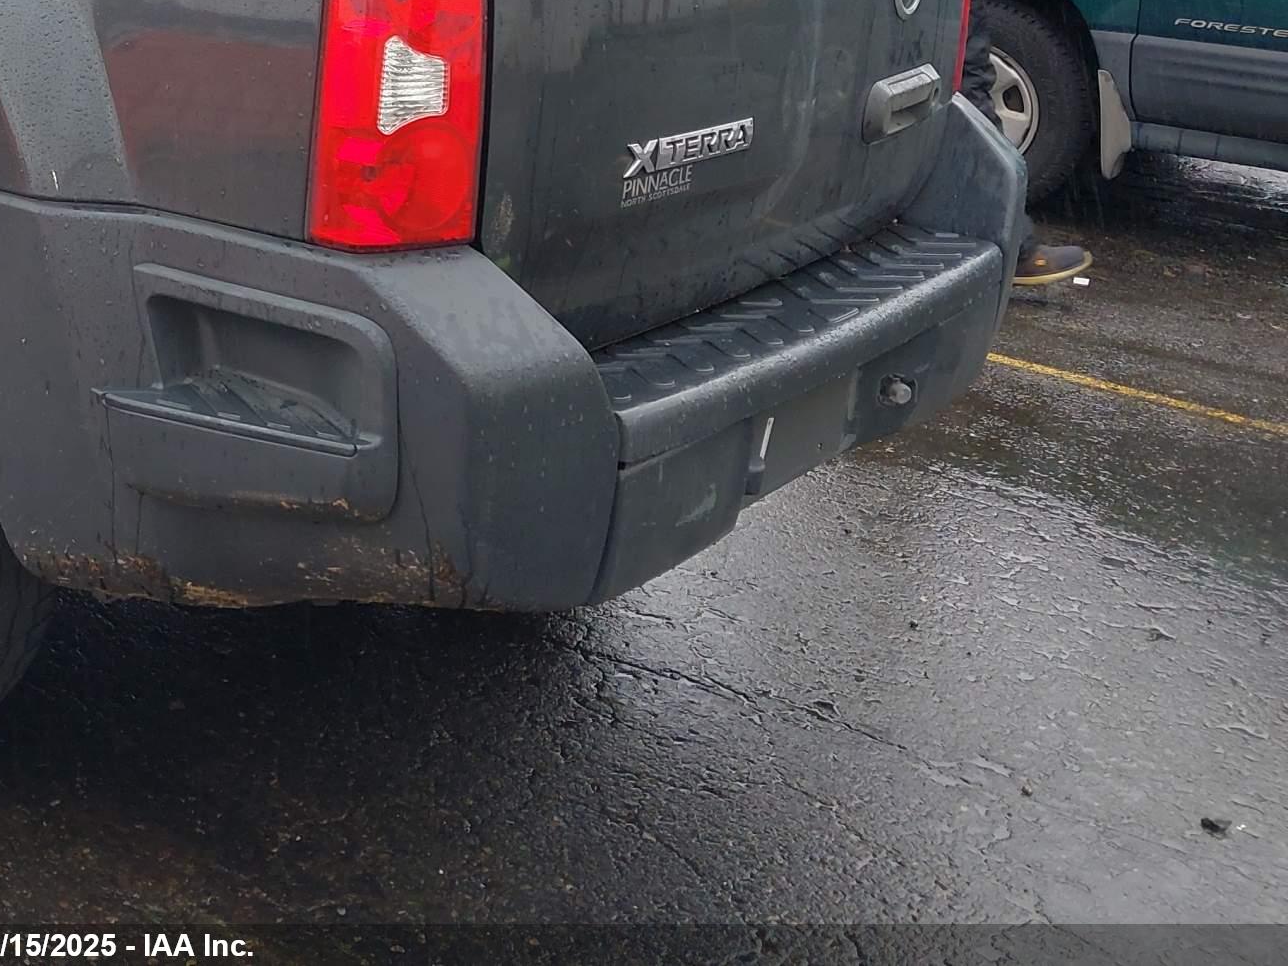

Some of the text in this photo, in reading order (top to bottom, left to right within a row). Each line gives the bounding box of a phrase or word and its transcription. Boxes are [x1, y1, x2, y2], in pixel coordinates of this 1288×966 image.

[623, 117, 754, 179] XTERRA
[620, 183, 691, 209] NORTH SCOTTSDALE
[622, 165, 693, 200] PINNACLE
